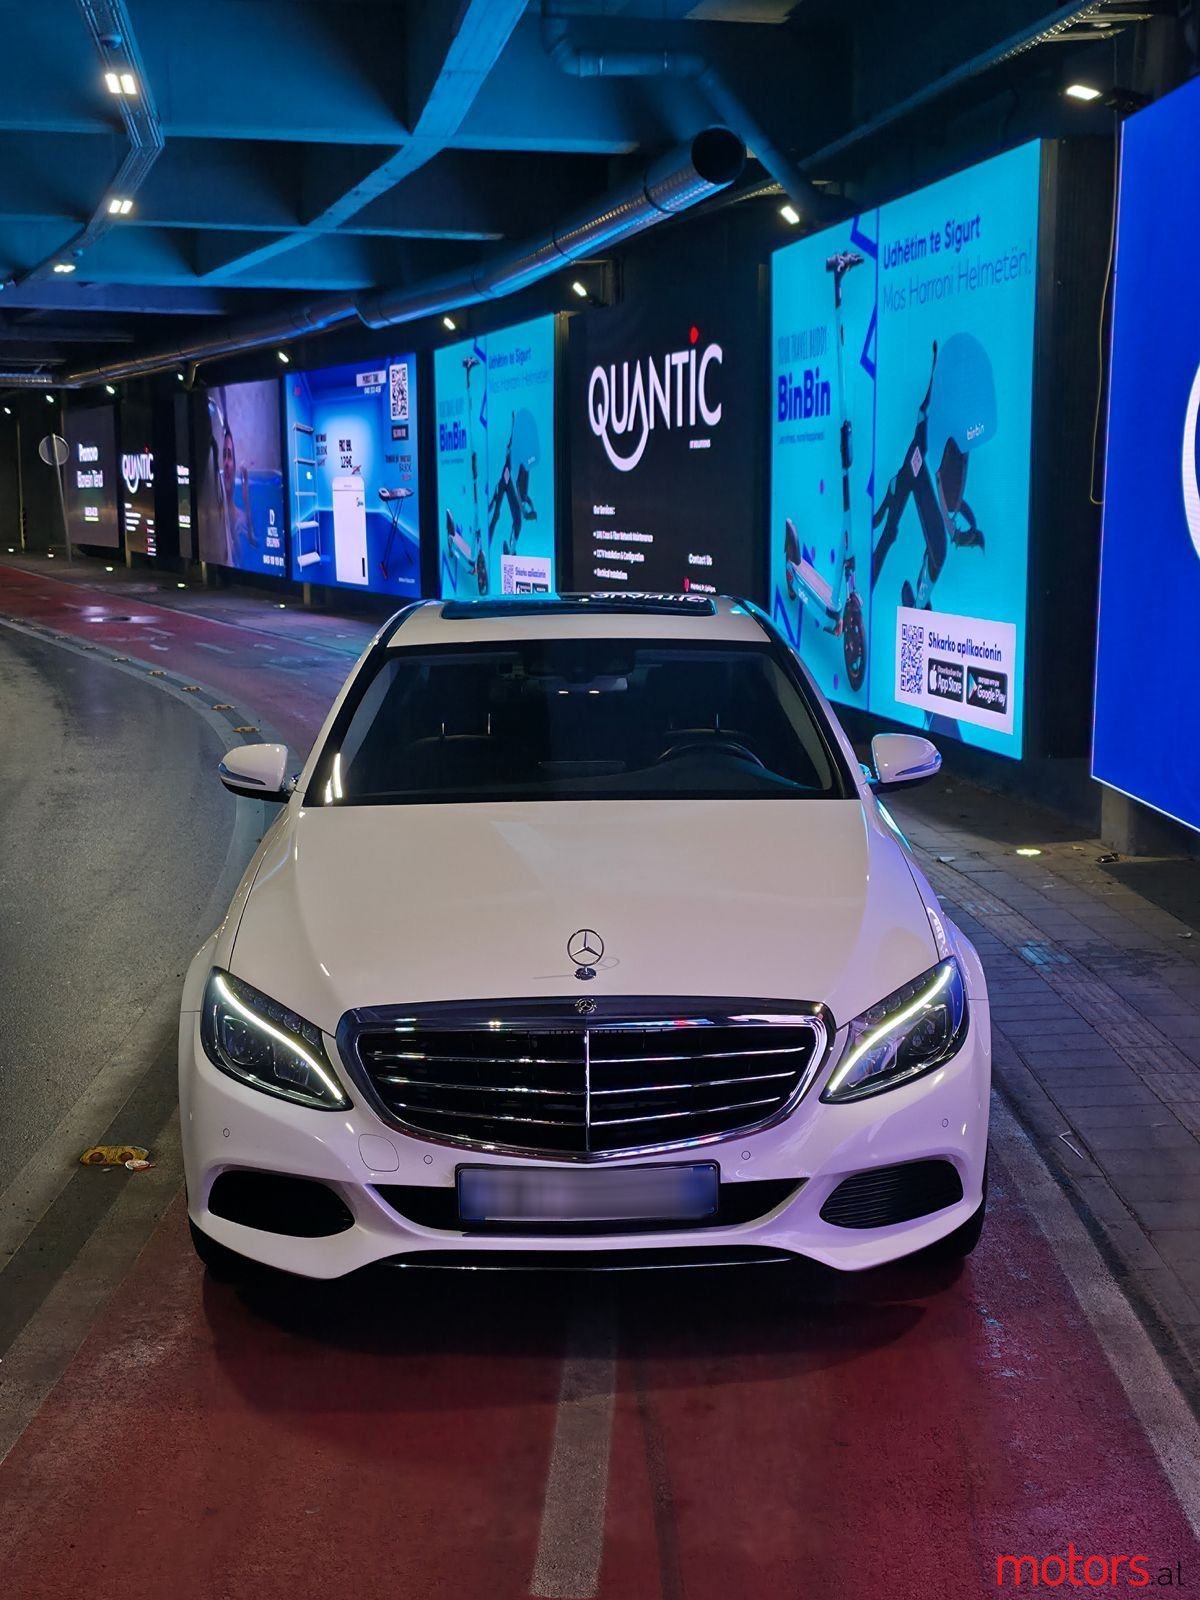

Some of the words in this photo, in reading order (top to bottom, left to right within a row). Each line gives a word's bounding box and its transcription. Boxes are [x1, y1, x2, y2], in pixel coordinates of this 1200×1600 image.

[883, 233, 927, 270] Udhëtim
[929, 229, 941, 254] te
[944, 213, 981, 254] Sigurt
[883, 282, 906, 313] Mas
[909, 265, 954, 306] Harroni
[957, 237, 1033, 294] Helmetën!
[777, 366, 831, 423] BinBin
[439, 420, 467, 452] BinBin
[928, 631, 956, 652] Shkarko
[956, 638, 1002, 663] aplikacionin
[937, 674, 948, 694] App
[948, 676, 962, 695] Store
[977, 684, 995, 704] Google
[995, 688, 1007, 707] Play
